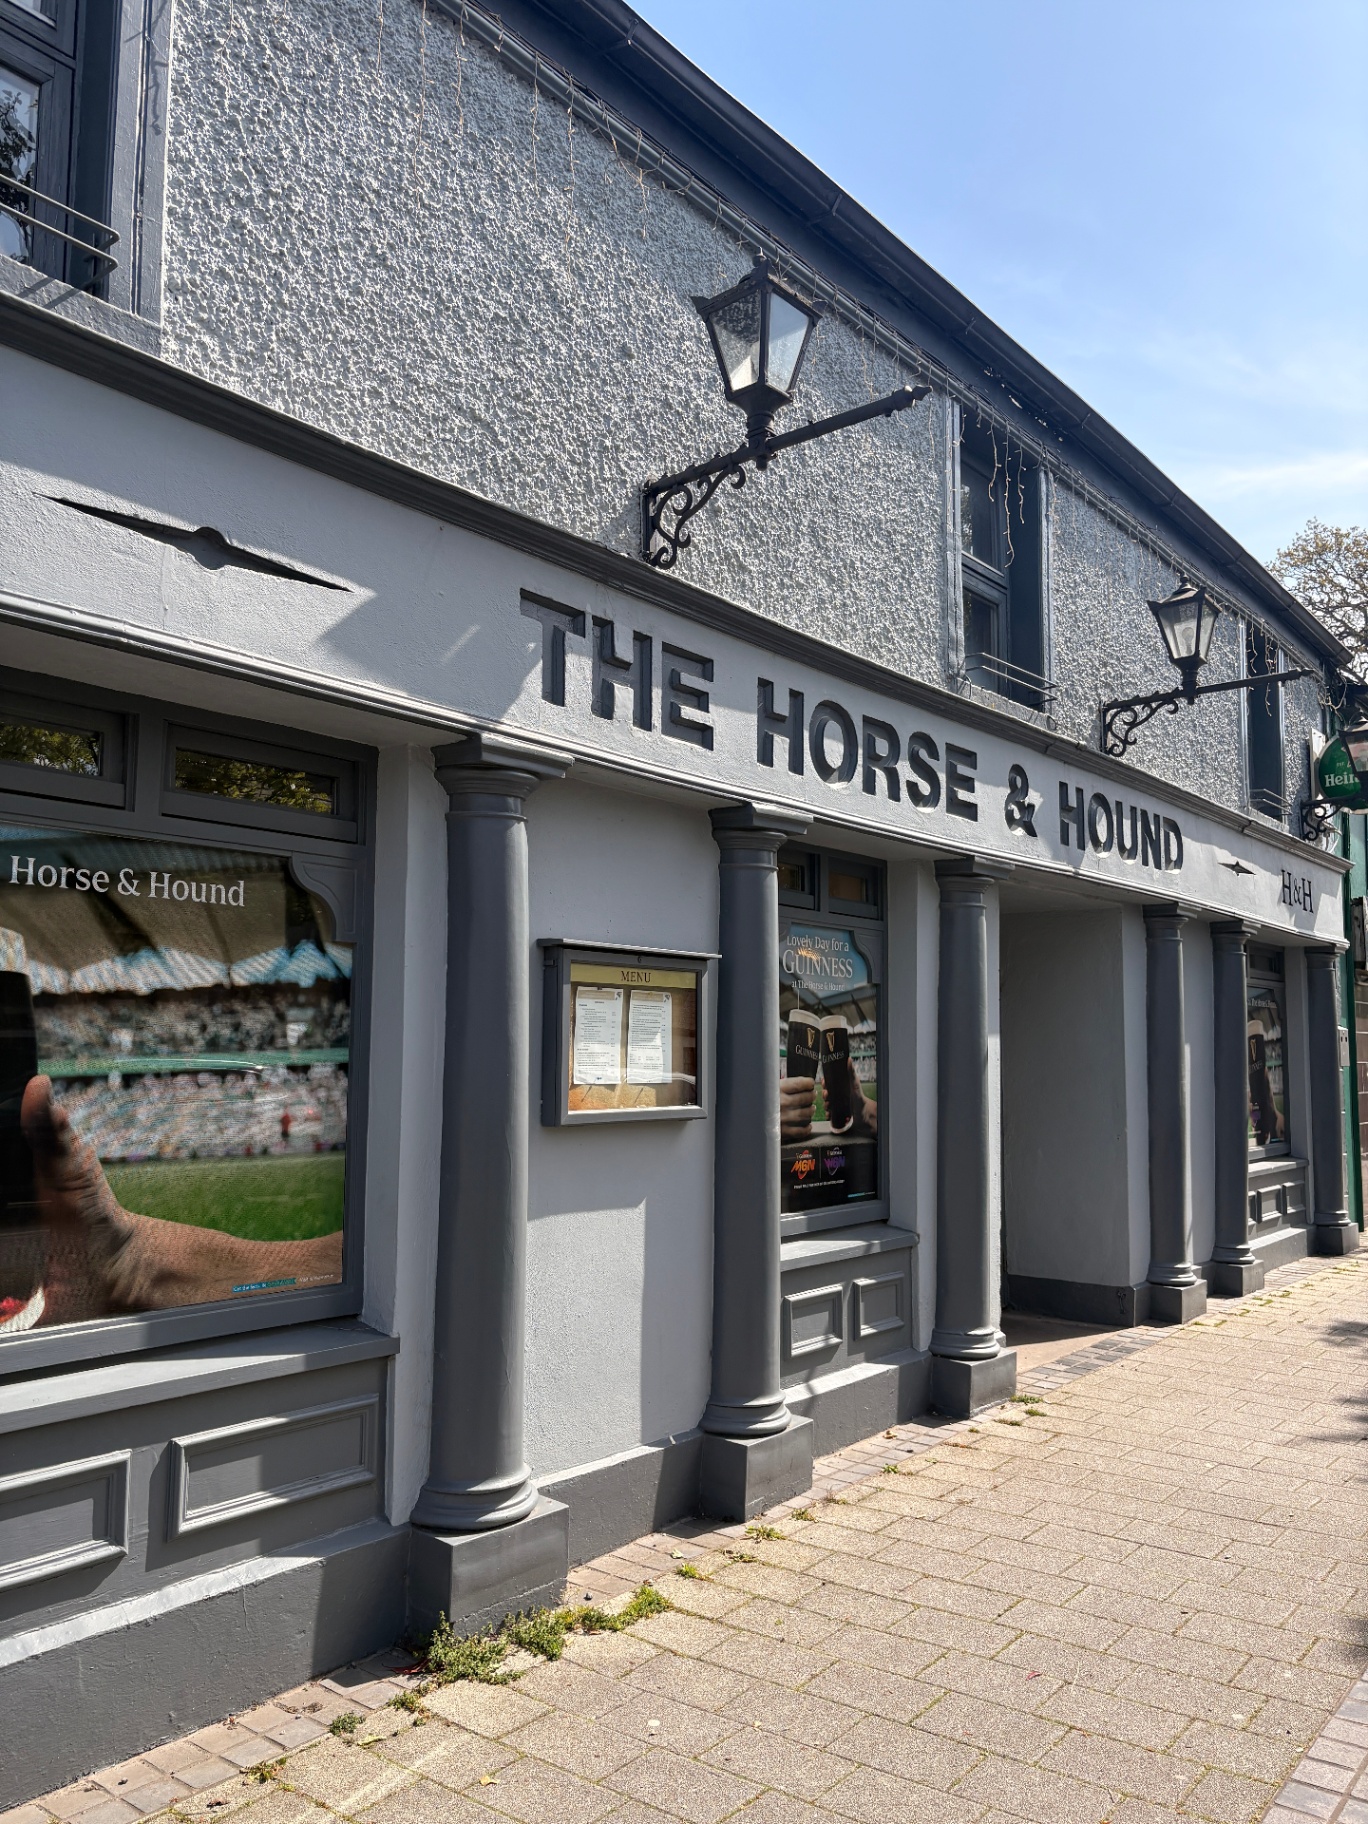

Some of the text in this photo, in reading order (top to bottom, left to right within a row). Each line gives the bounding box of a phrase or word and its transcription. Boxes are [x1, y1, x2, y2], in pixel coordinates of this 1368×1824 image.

[520, 588, 1184, 875] THE HORSE & HOUND
[1324, 771, 1360, 788] Hein
[8, 855, 245, 907] Horse & Hound
[1280, 869, 1315, 914] H&H
[786, 934, 849, 952] Lovely Day for a
[620, 970, 651, 983] MENU
[782, 949, 853, 979] GUINNESS
